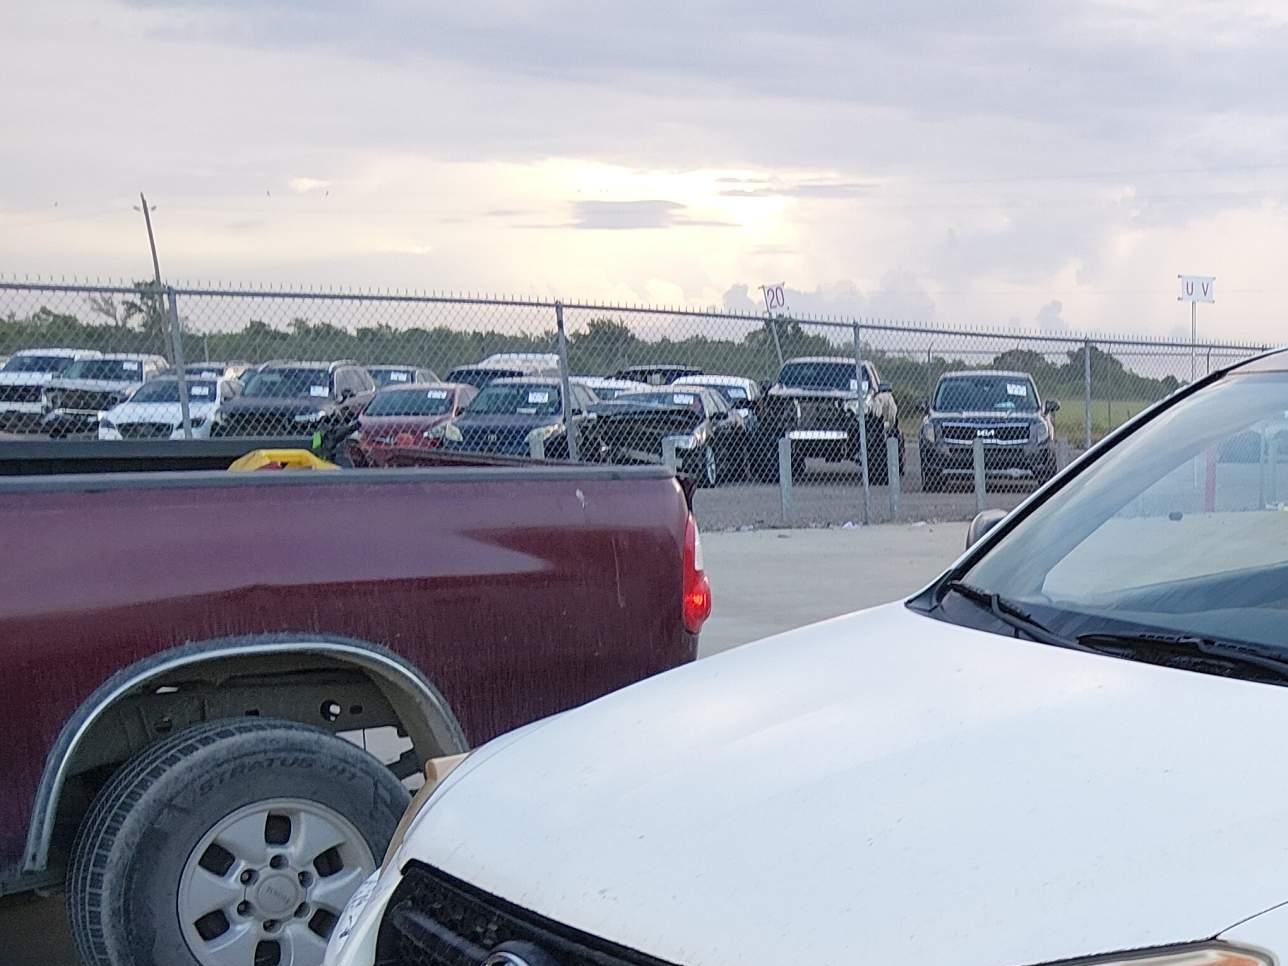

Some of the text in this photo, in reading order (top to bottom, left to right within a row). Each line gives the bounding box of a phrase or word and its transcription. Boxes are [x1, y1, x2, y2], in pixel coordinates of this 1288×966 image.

[766, 286, 785, 309] 20
[1186, 280, 1210, 297] U V
